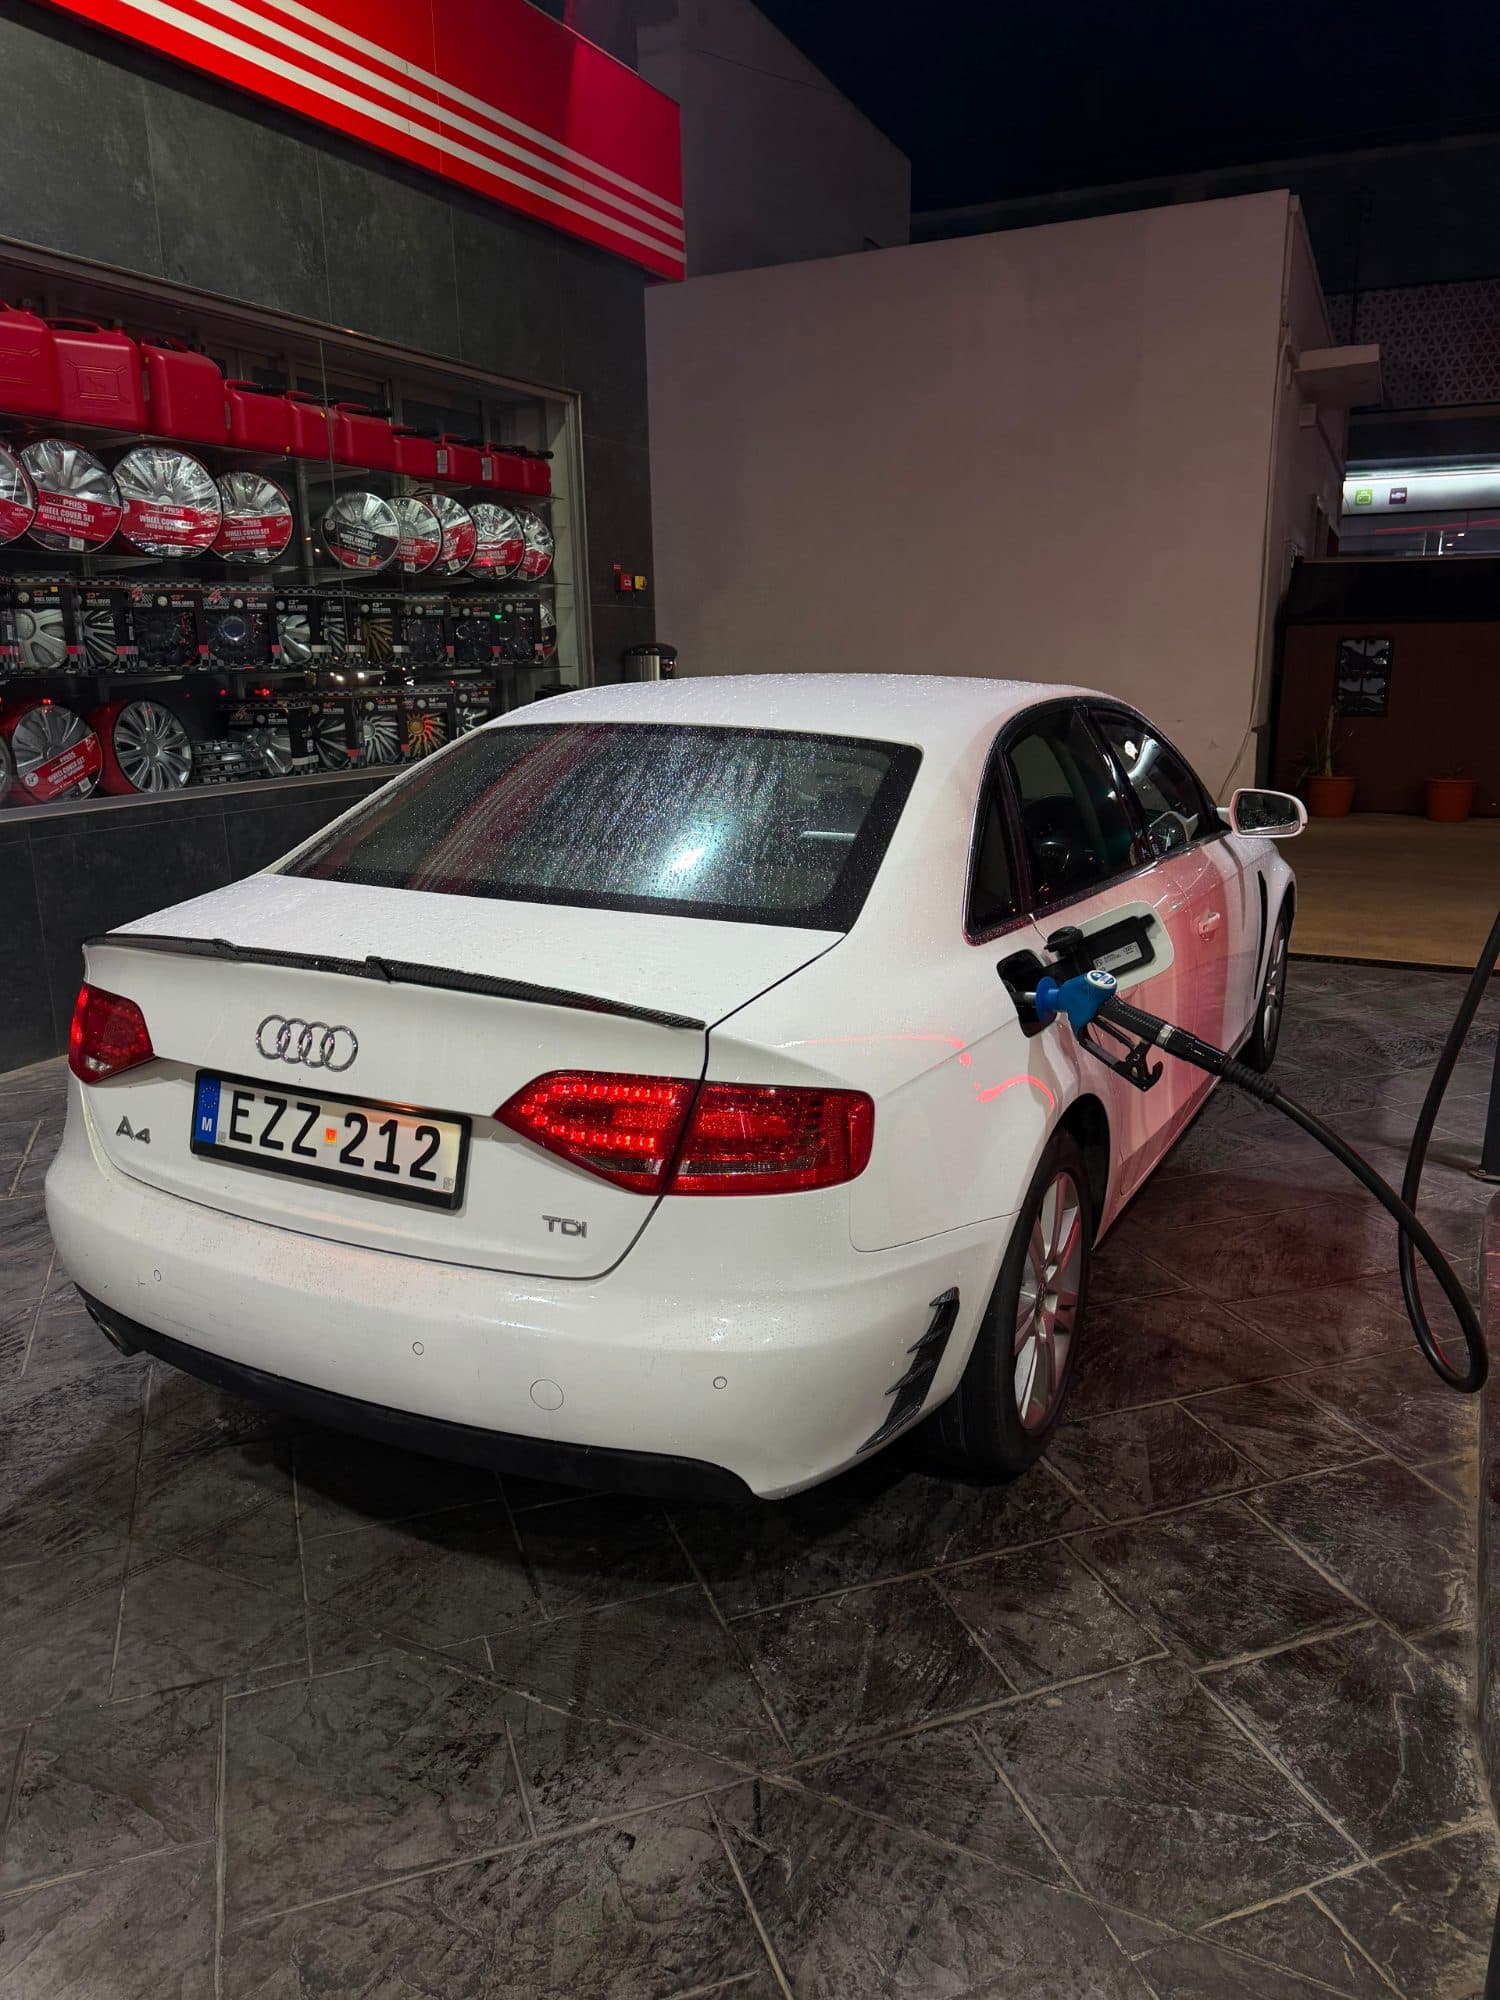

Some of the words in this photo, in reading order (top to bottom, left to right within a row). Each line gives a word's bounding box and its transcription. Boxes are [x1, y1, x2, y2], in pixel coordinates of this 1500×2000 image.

[60, 508, 83, 521] COVER
[83, 513, 95, 524] SET
[116, 1115, 151, 1145] A4
[201, 1116, 213, 1132] M
[229, 1090, 321, 1158] EZZ
[339, 1112, 441, 1182] 212
[542, 1215, 588, 1239] TDI
